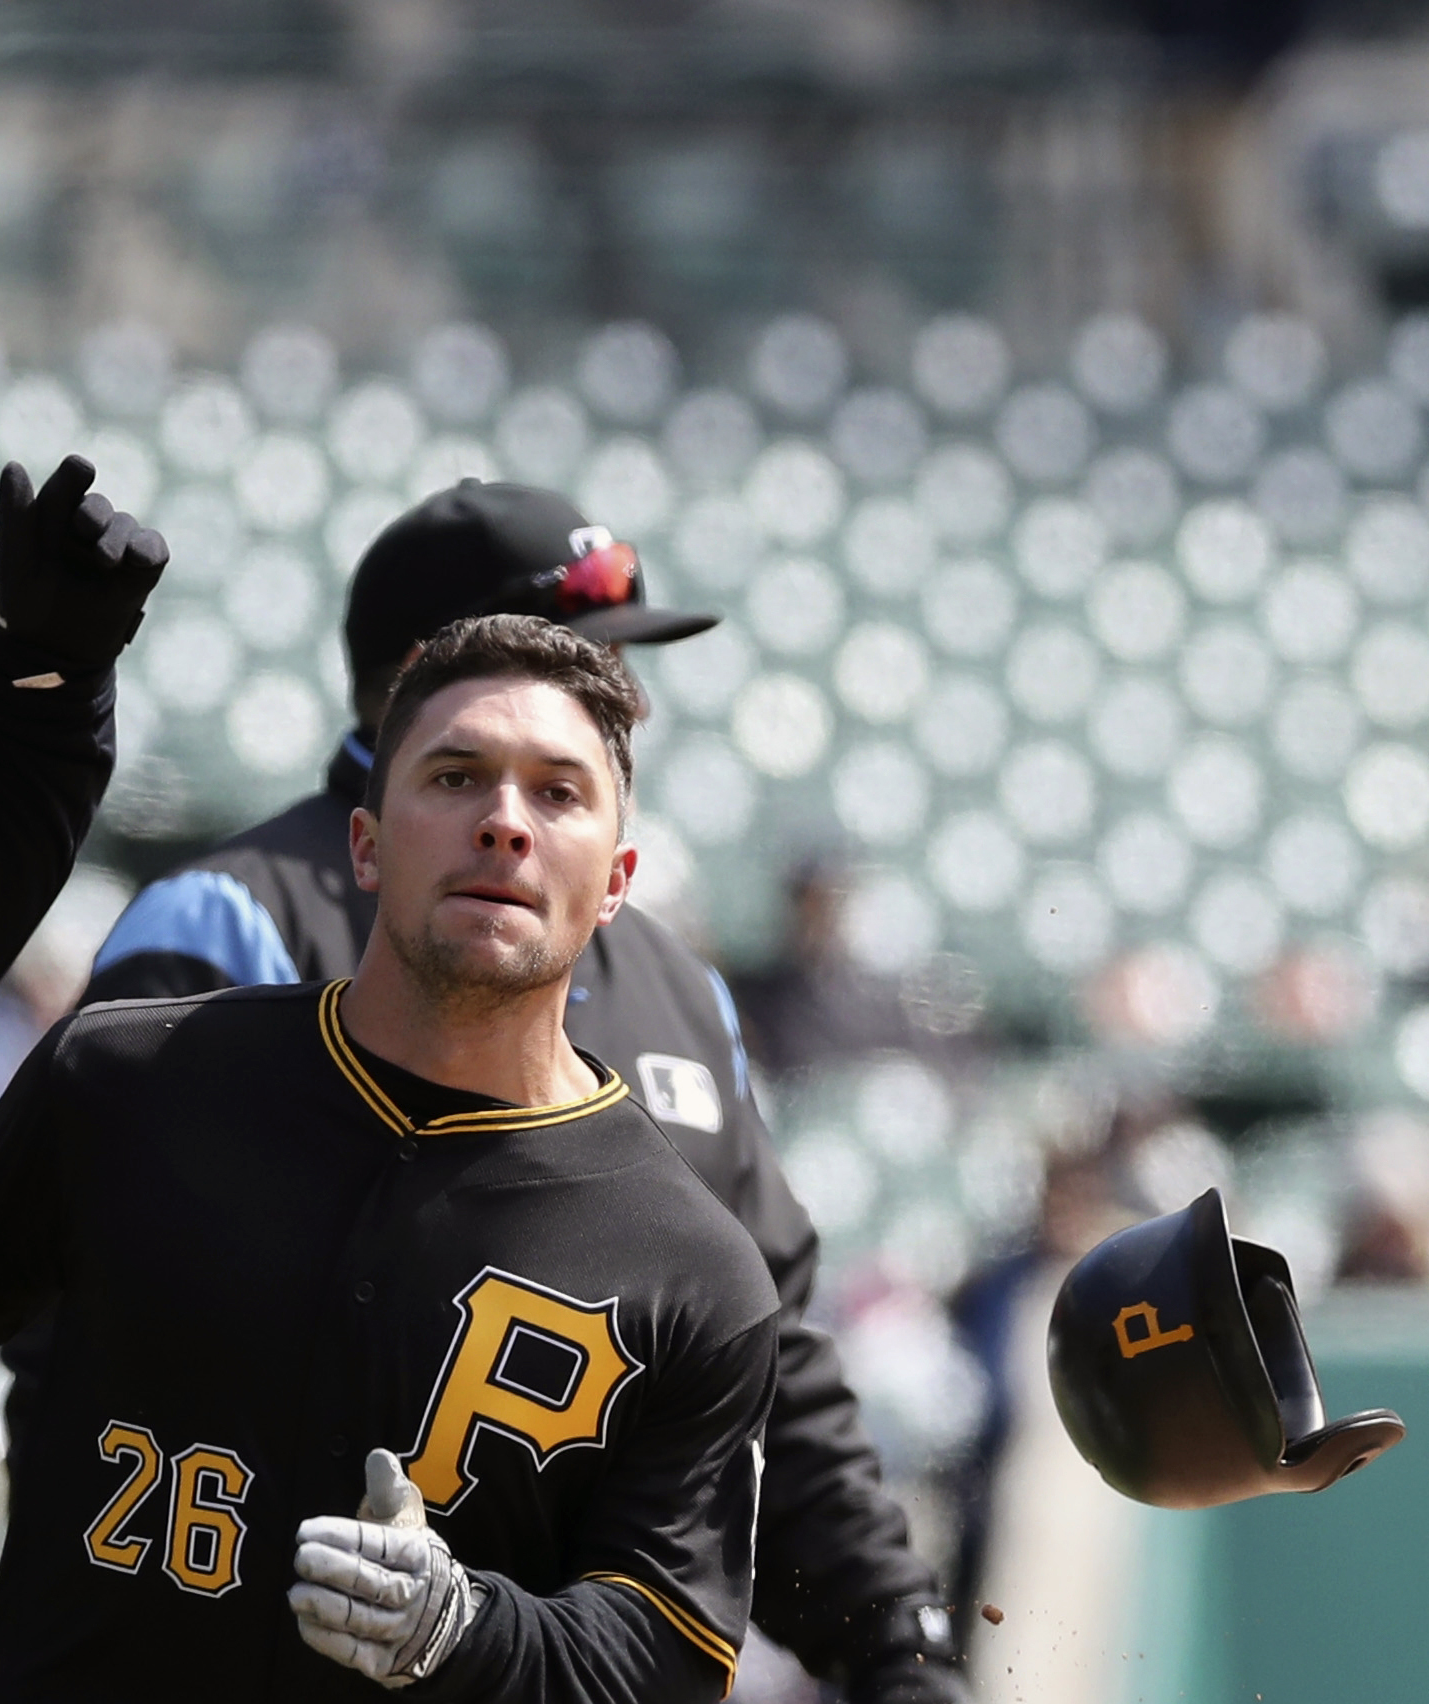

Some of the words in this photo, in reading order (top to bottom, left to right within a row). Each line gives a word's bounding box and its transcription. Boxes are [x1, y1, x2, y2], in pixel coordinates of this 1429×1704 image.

[398, 1265, 646, 1516] P
[1111, 1300, 1195, 1359] P
[83, 1419, 255, 1598] 26
